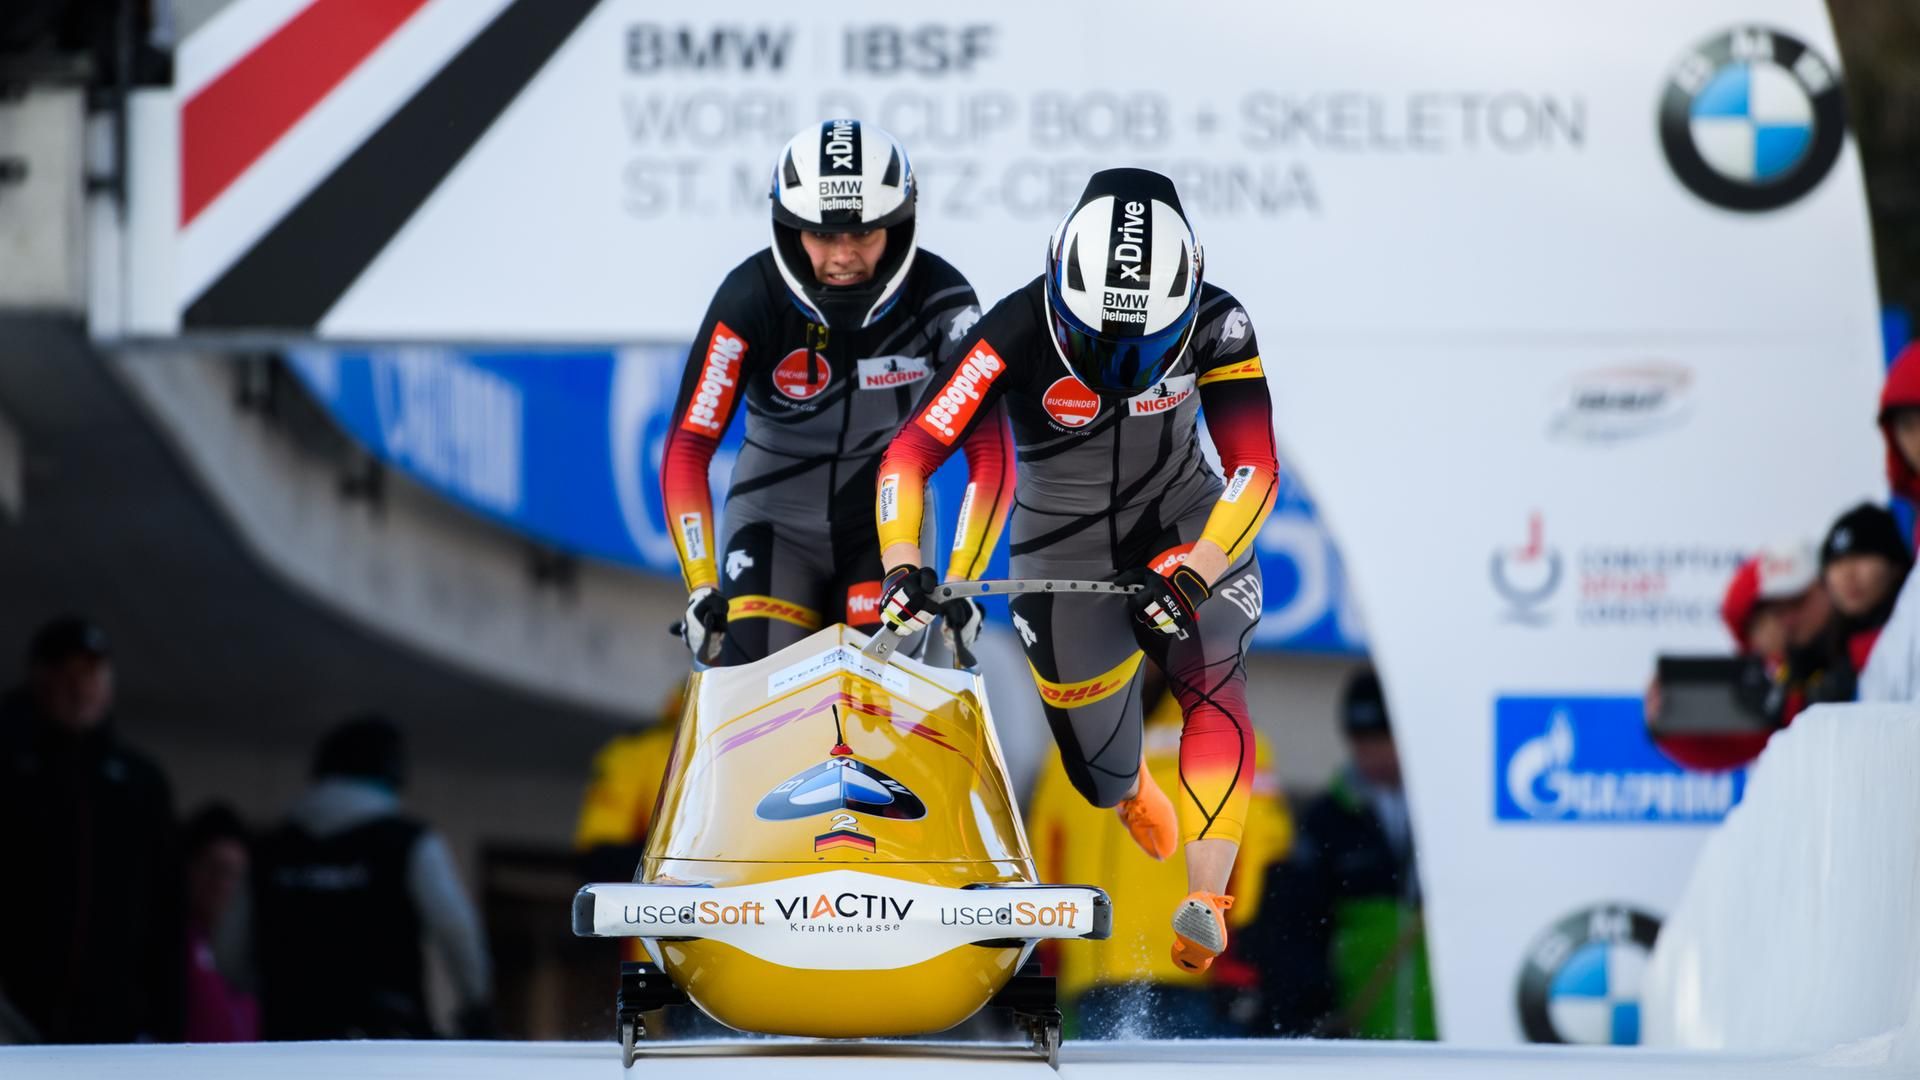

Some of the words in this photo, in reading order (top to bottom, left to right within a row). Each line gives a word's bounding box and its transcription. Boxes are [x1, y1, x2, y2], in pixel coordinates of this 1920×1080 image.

[624, 23, 794, 76] BMW
[843, 23, 998, 77] IBSF
[878, 88, 1016, 152] CUP
[1032, 89, 1172, 152] BOB
[1241, 90, 1588, 153] SKELETON
[826, 120, 853, 170] xDrive
[819, 180, 863, 196] BMW
[820, 196, 863, 211] helmets
[1115, 201, 1145, 282] xDrive
[1103, 291, 1149, 309] BMW
[1102, 308, 1147, 323] helmets
[866, 370, 925, 387] NIGRIN
[1046, 397, 1097, 409] BUCHBINDER
[1135, 387, 1190, 413] NIGRIN
[742, 600, 808, 621] DHL
[1041, 681, 1108, 703] DHL
[774, 758, 913, 796] BMW
[831, 813, 859, 832] 2
[624, 901, 765, 926] usedSoft
[775, 892, 914, 922] VIACTIV
[941, 901, 1078, 929] usedSoft
[790, 921, 901, 933] Krankenkasse
